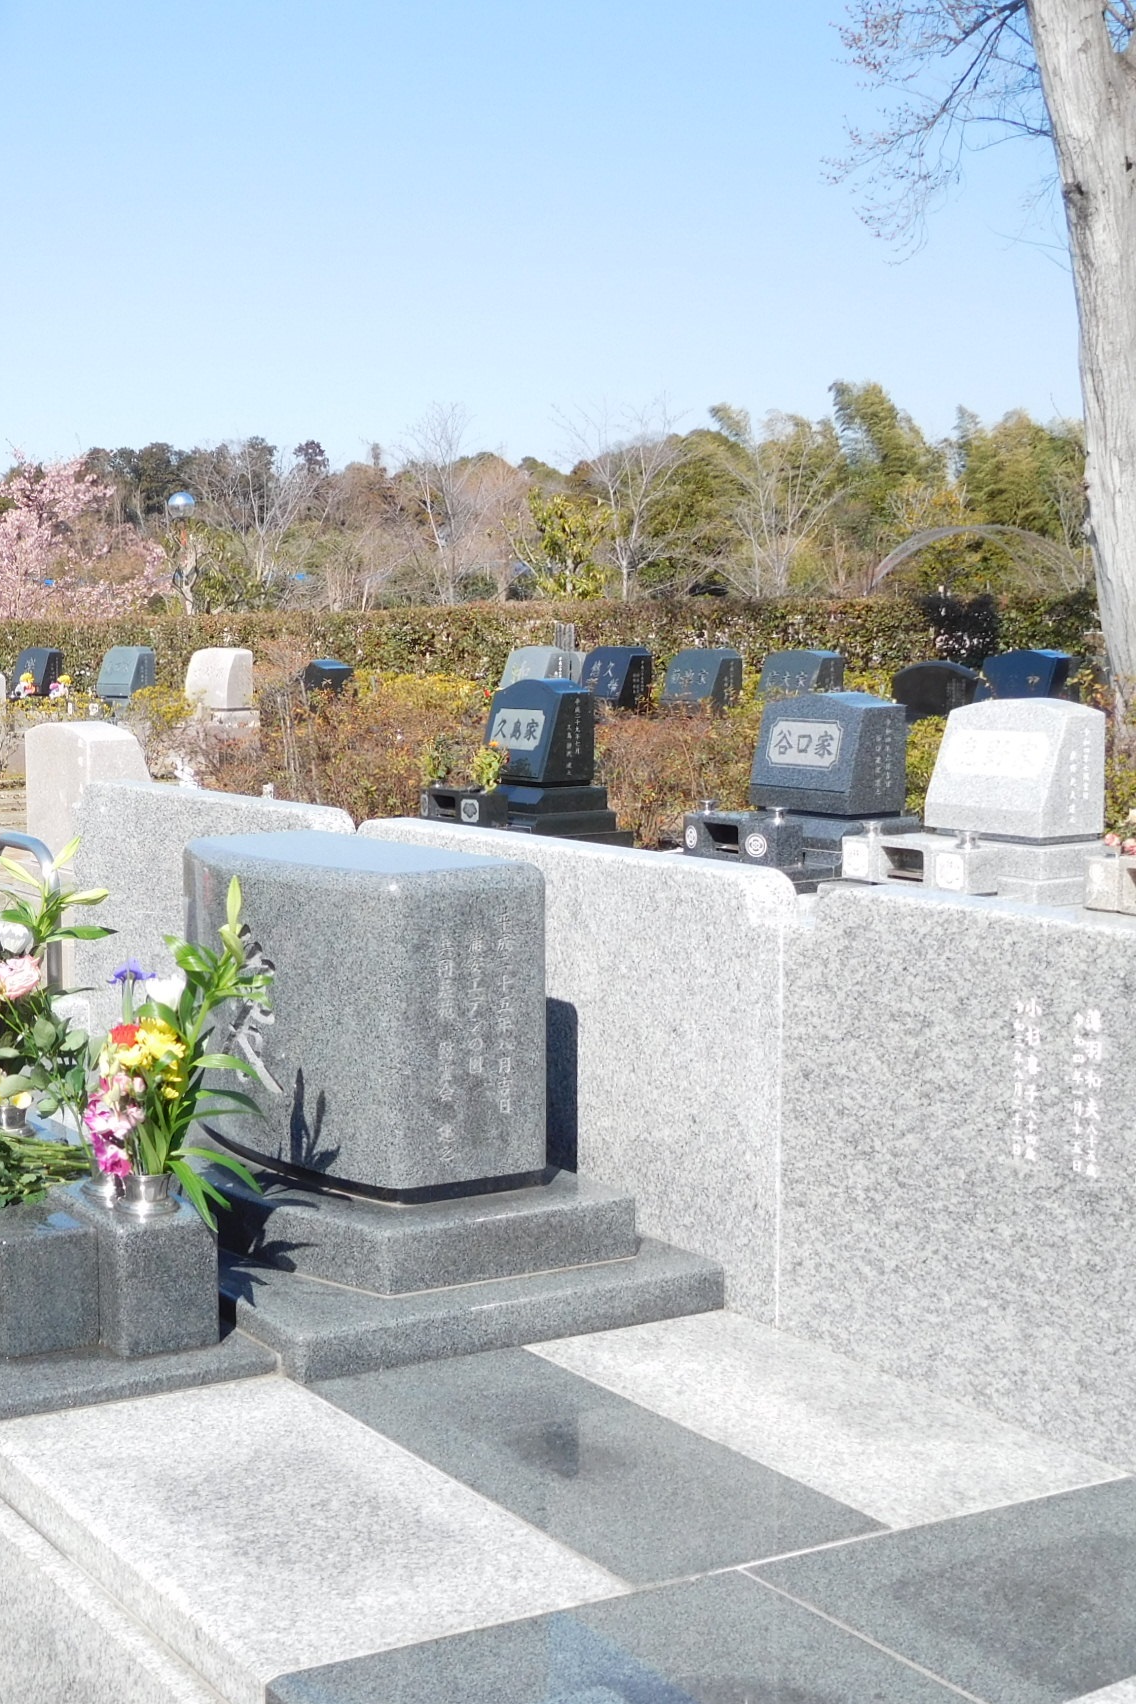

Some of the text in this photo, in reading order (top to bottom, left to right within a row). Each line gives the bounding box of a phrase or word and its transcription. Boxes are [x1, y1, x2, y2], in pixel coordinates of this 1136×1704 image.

[494, 717, 539, 742] 久島家
[774, 729, 834, 758] 谷口家
